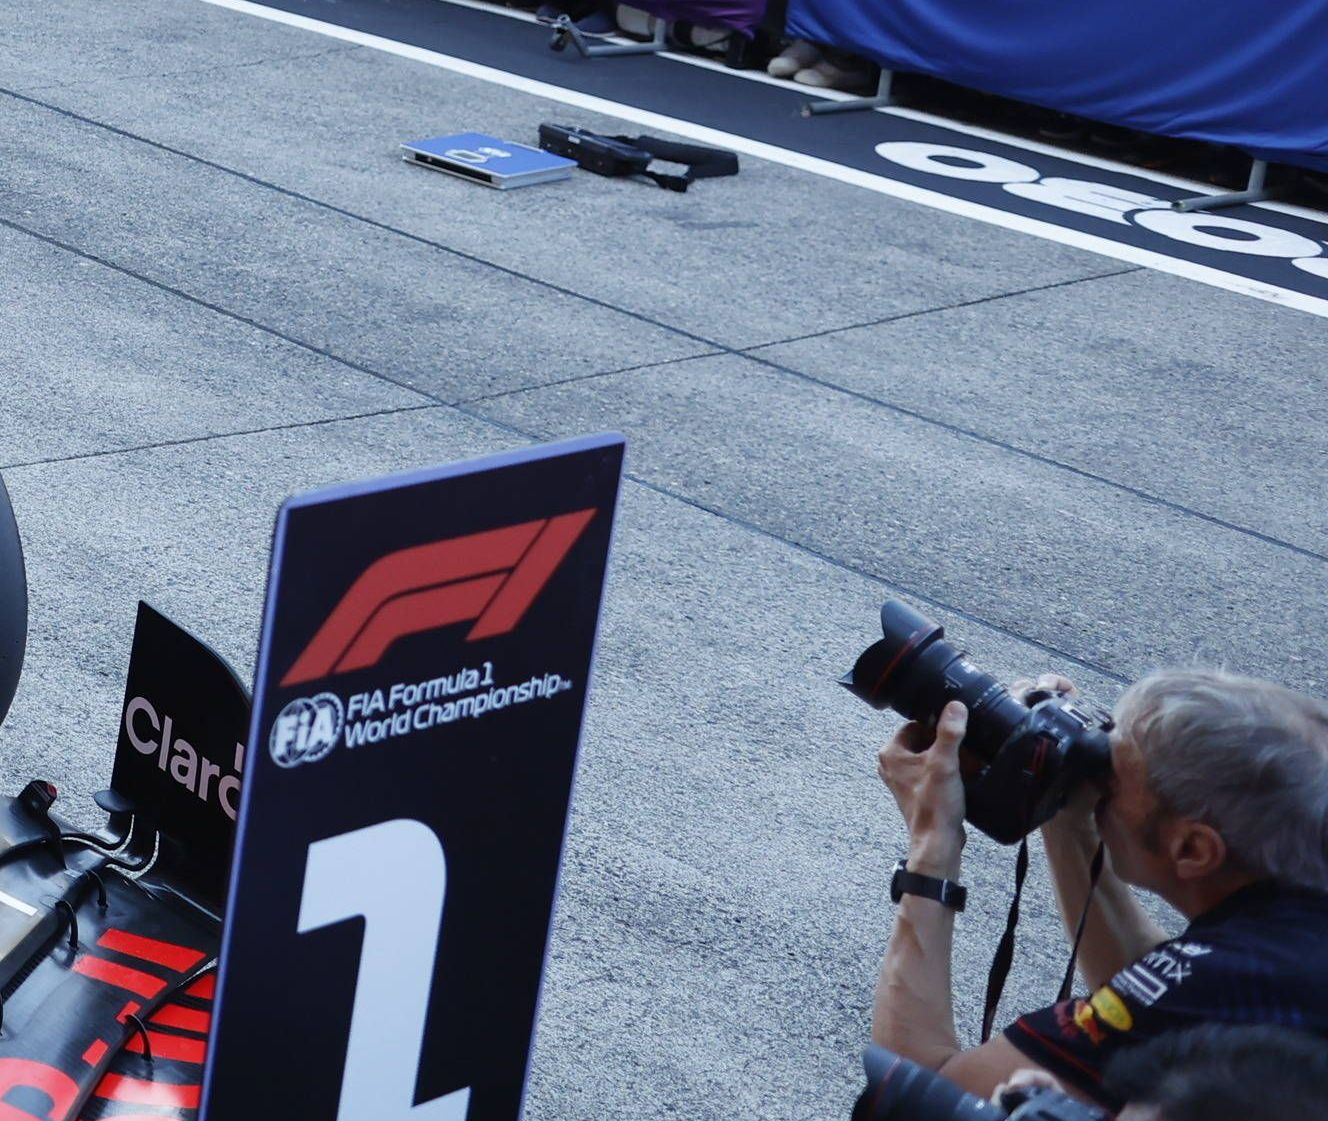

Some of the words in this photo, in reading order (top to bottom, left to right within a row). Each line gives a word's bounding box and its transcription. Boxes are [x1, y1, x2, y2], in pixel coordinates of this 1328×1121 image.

[875, 141, 1328, 278] 030
[278, 508, 598, 687] F1
[344, 711, 411, 749] World
[347, 693, 386, 721] FIA
[388, 669, 481, 708] Formula
[481, 660, 495, 687] 1
[297, 818, 472, 1121] 1
